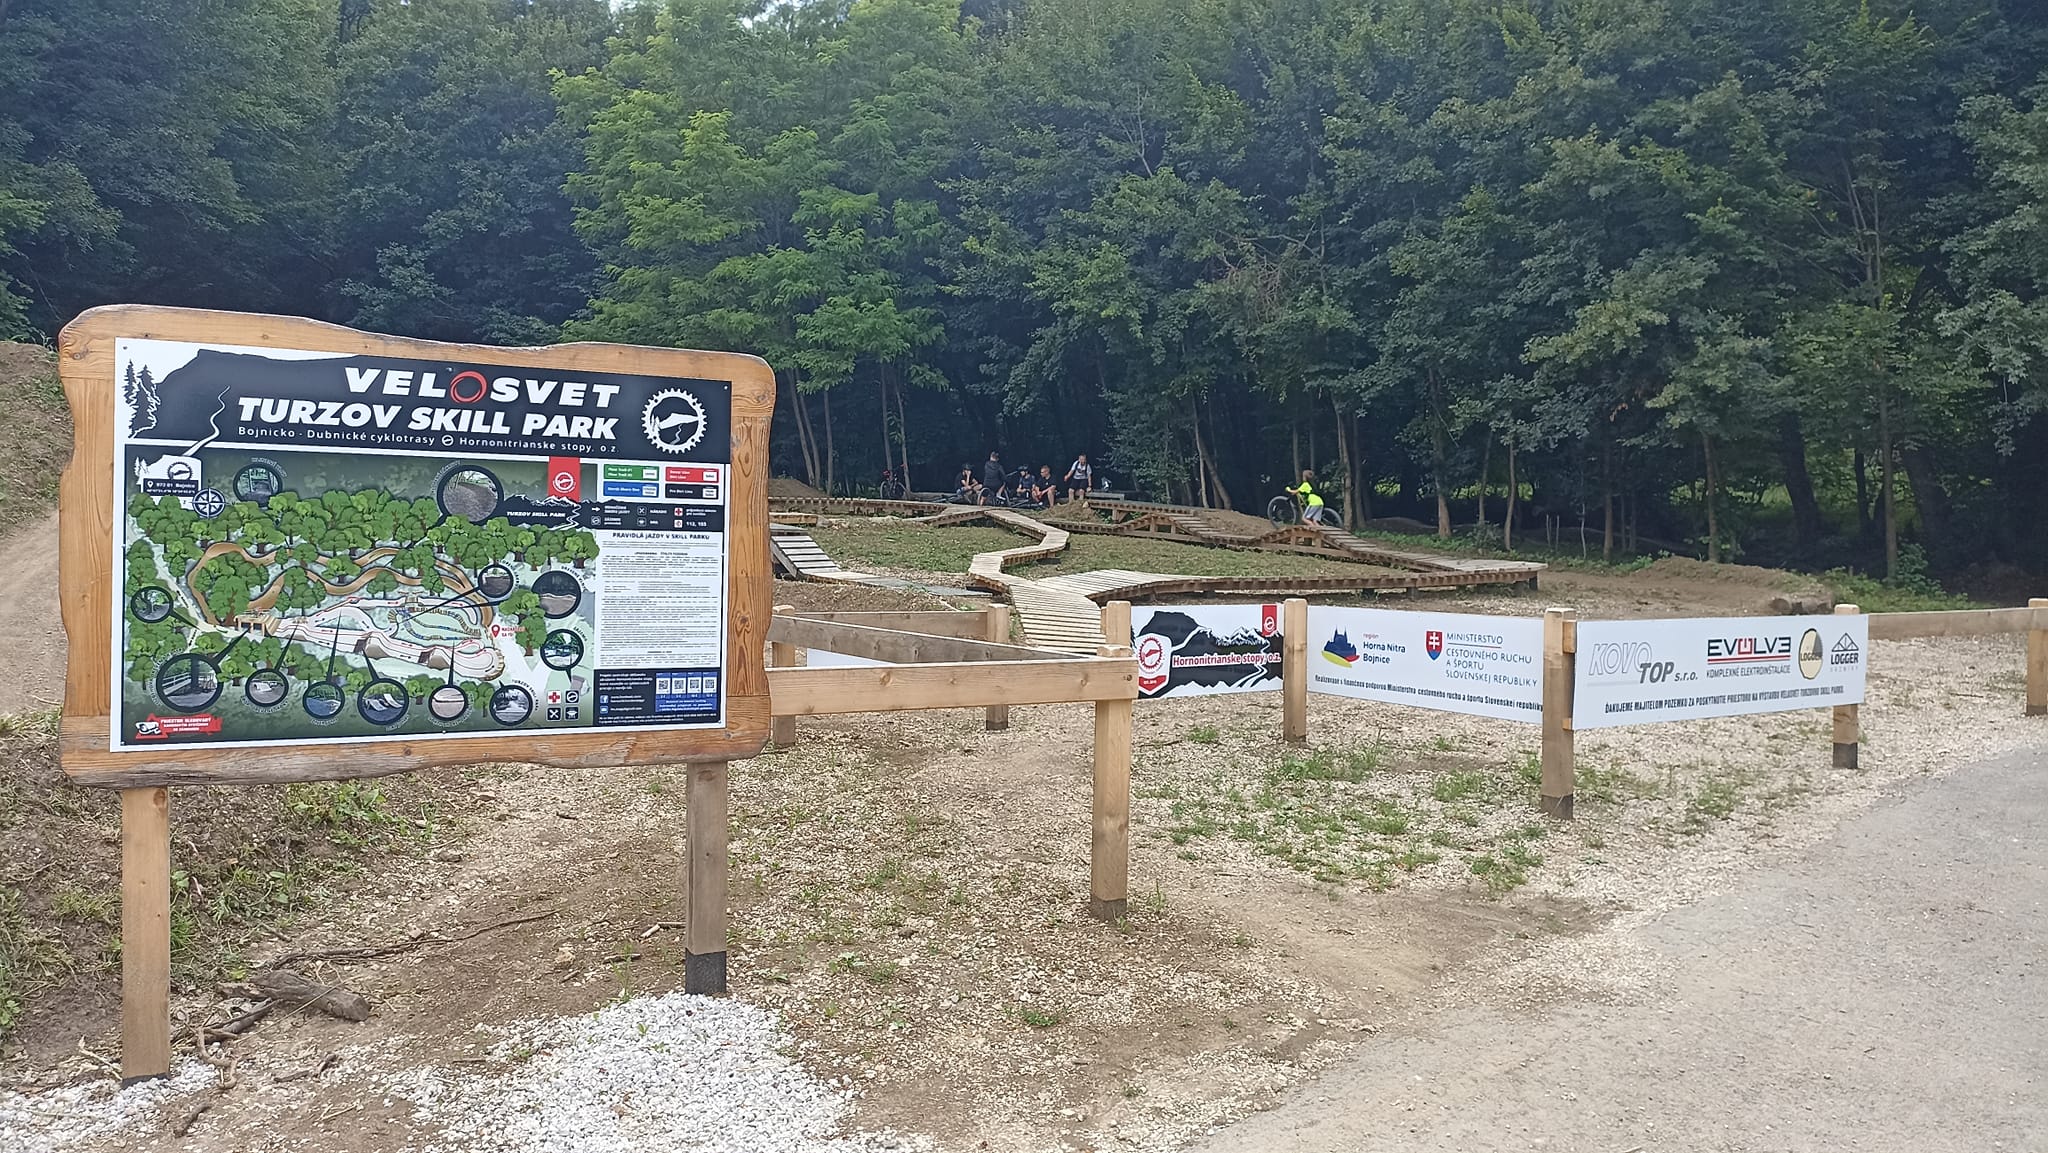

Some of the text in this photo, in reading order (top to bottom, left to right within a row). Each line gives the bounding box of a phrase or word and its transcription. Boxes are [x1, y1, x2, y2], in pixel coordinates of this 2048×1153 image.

[344, 367, 621, 408] VELOSVET
[238, 397, 619, 440] TURZOV SKILL PARK
[238, 426, 295, 438] Bojnicko
[307, 429, 367, 441] Dubnické
[370, 432, 436, 446] cyklotrasy
[459, 437, 556, 450] Hornonitrianske
[689, 533, 710, 541] PARKU
[1446, 632, 1504, 645] MINISTERSTVO
[1363, 641, 1406, 653] Horna Nitra
[1173, 653, 1241, 667] Hornonitrianske
[1363, 653, 1391, 665] Bojnice
[1446, 648, 1532, 664] CESTOVNÉHO RUCHU
[1588, 641, 1653, 676] KOVO
[1830, 652, 1859, 665] LOGGER
[1454, 658, 1485, 671] ŠPORTU
[1639, 661, 1698, 684] TOP s.r.o.
[1446, 669, 1537, 687] SLOVENSKEJ REPUBLIKY
[1484, 695, 1515, 708] Slovenskej
[1516, 700, 1544, 712] republiky
[1604, 702, 1633, 714] ĎAKUJEME
[1664, 698, 1687, 709] POZEMKU
[1688, 697, 1694, 707] ZA
